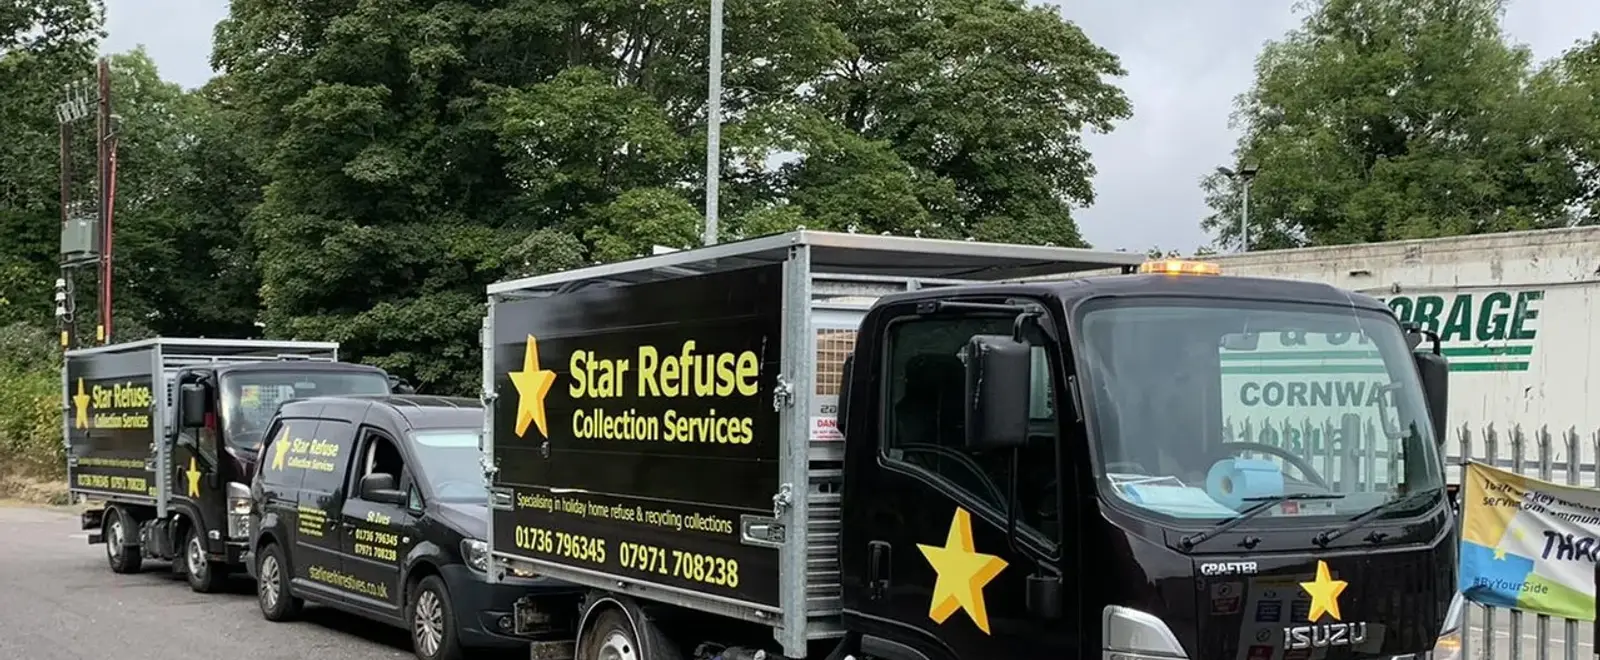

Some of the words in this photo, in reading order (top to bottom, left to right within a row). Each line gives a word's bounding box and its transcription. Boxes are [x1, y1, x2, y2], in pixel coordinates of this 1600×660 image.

[569, 347, 631, 399] Star
[638, 339, 759, 398] Refuse
[92, 383, 113, 409] Star
[113, 380, 149, 408] Refuse
[1239, 380, 1396, 407] CORNWA
[94, 412, 122, 428] Collection
[122, 412, 149, 428] Services
[572, 408, 658, 441] Collection
[663, 410, 753, 445] Services
[816, 419, 838, 428] DAN
[291, 437, 310, 453] Star
[309, 439, 339, 457] Refuse
[516, 492, 553, 513] Specialising
[554, 495, 562, 507] in
[562, 495, 587, 518] holiday
[588, 500, 609, 518] home
[611, 503, 635, 520] refuse
[635, 507, 644, 522] &
[645, 509, 682, 531] recycling
[684, 513, 733, 534] collections
[354, 528, 374, 543] 01736
[374, 531, 398, 547] 796345
[515, 525, 554, 554] 01736
[555, 531, 606, 564] 796345
[619, 541, 669, 575] 07971
[672, 550, 739, 588] 708238
[1200, 561, 1258, 575] GRAFTER
[1473, 576, 1549, 594] #ByYourSide
[1283, 621, 1367, 650] ISUZU
